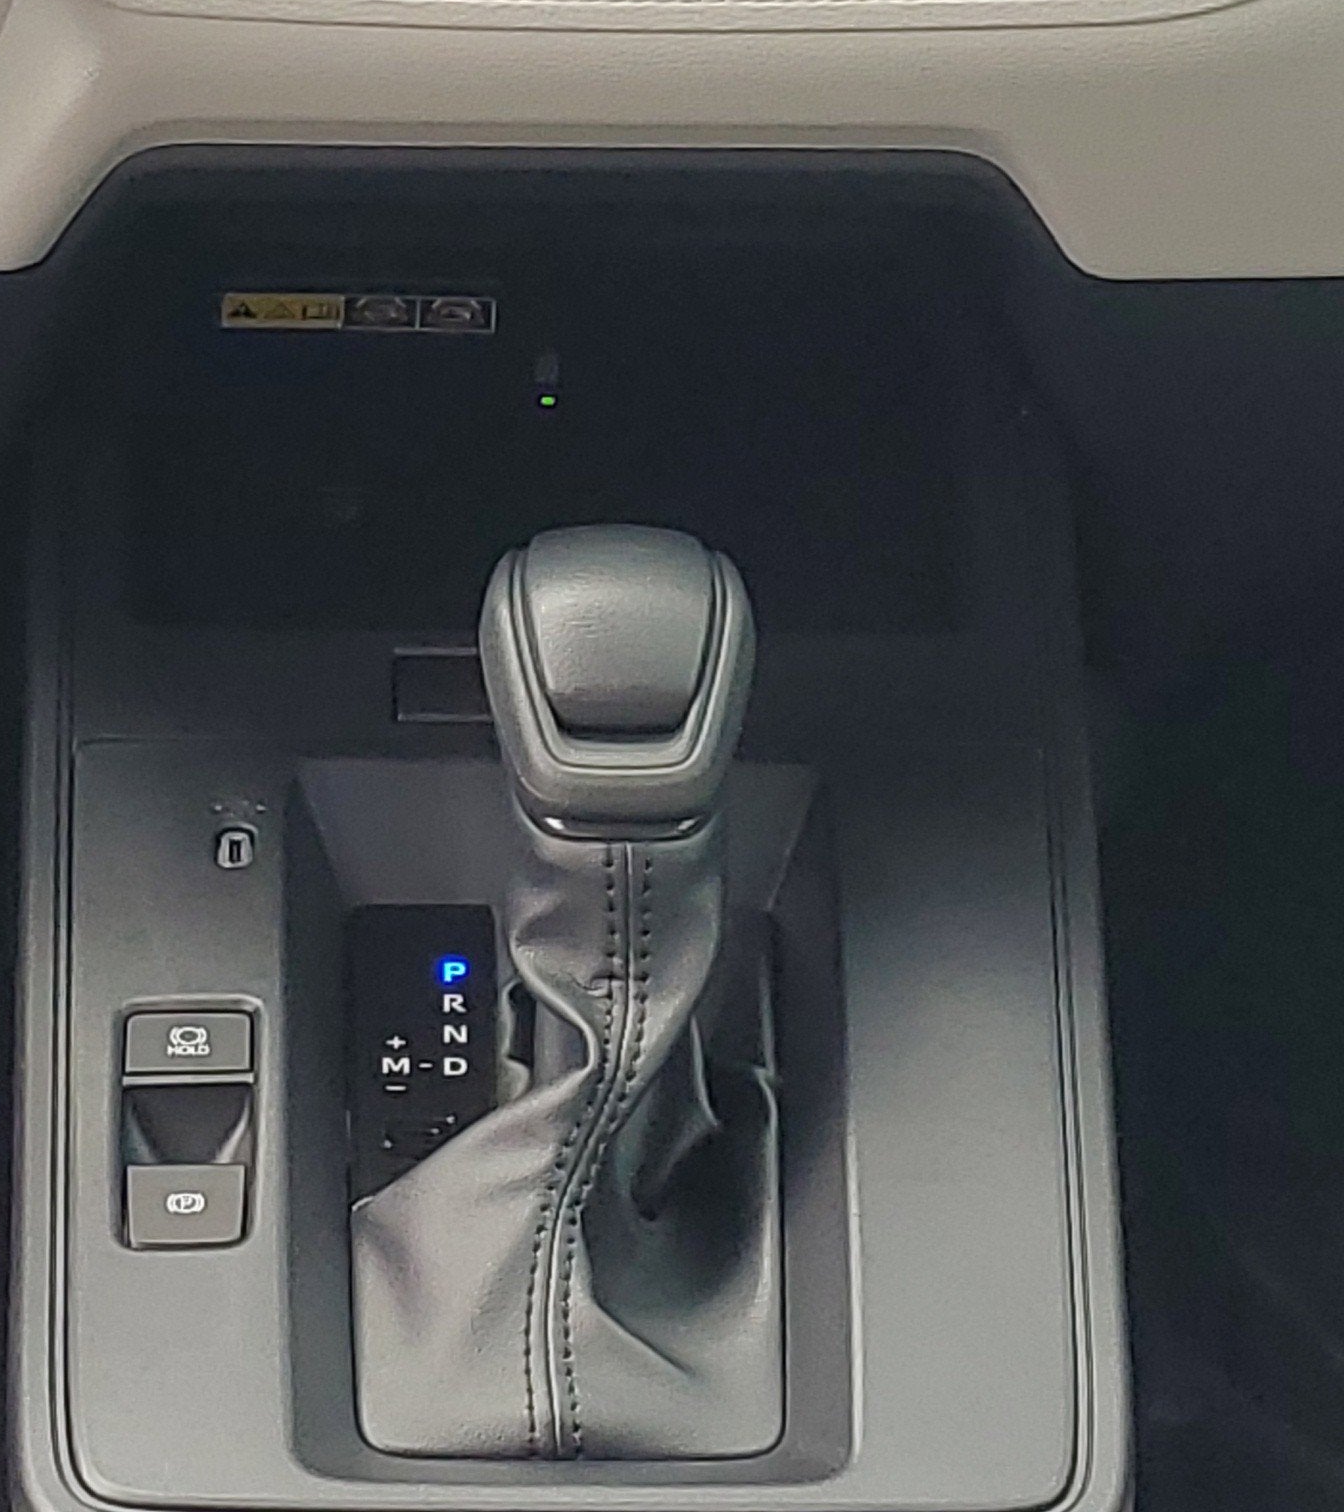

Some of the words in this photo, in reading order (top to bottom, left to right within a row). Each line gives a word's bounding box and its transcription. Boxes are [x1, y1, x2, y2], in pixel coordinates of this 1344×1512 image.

[442, 962, 467, 982] P
[443, 994, 467, 1014] R
[444, 1025, 468, 1045] N
[167, 1045, 210, 1057] HOLD
[381, 1057, 411, 1076] M
[444, 1058, 468, 1078] D
